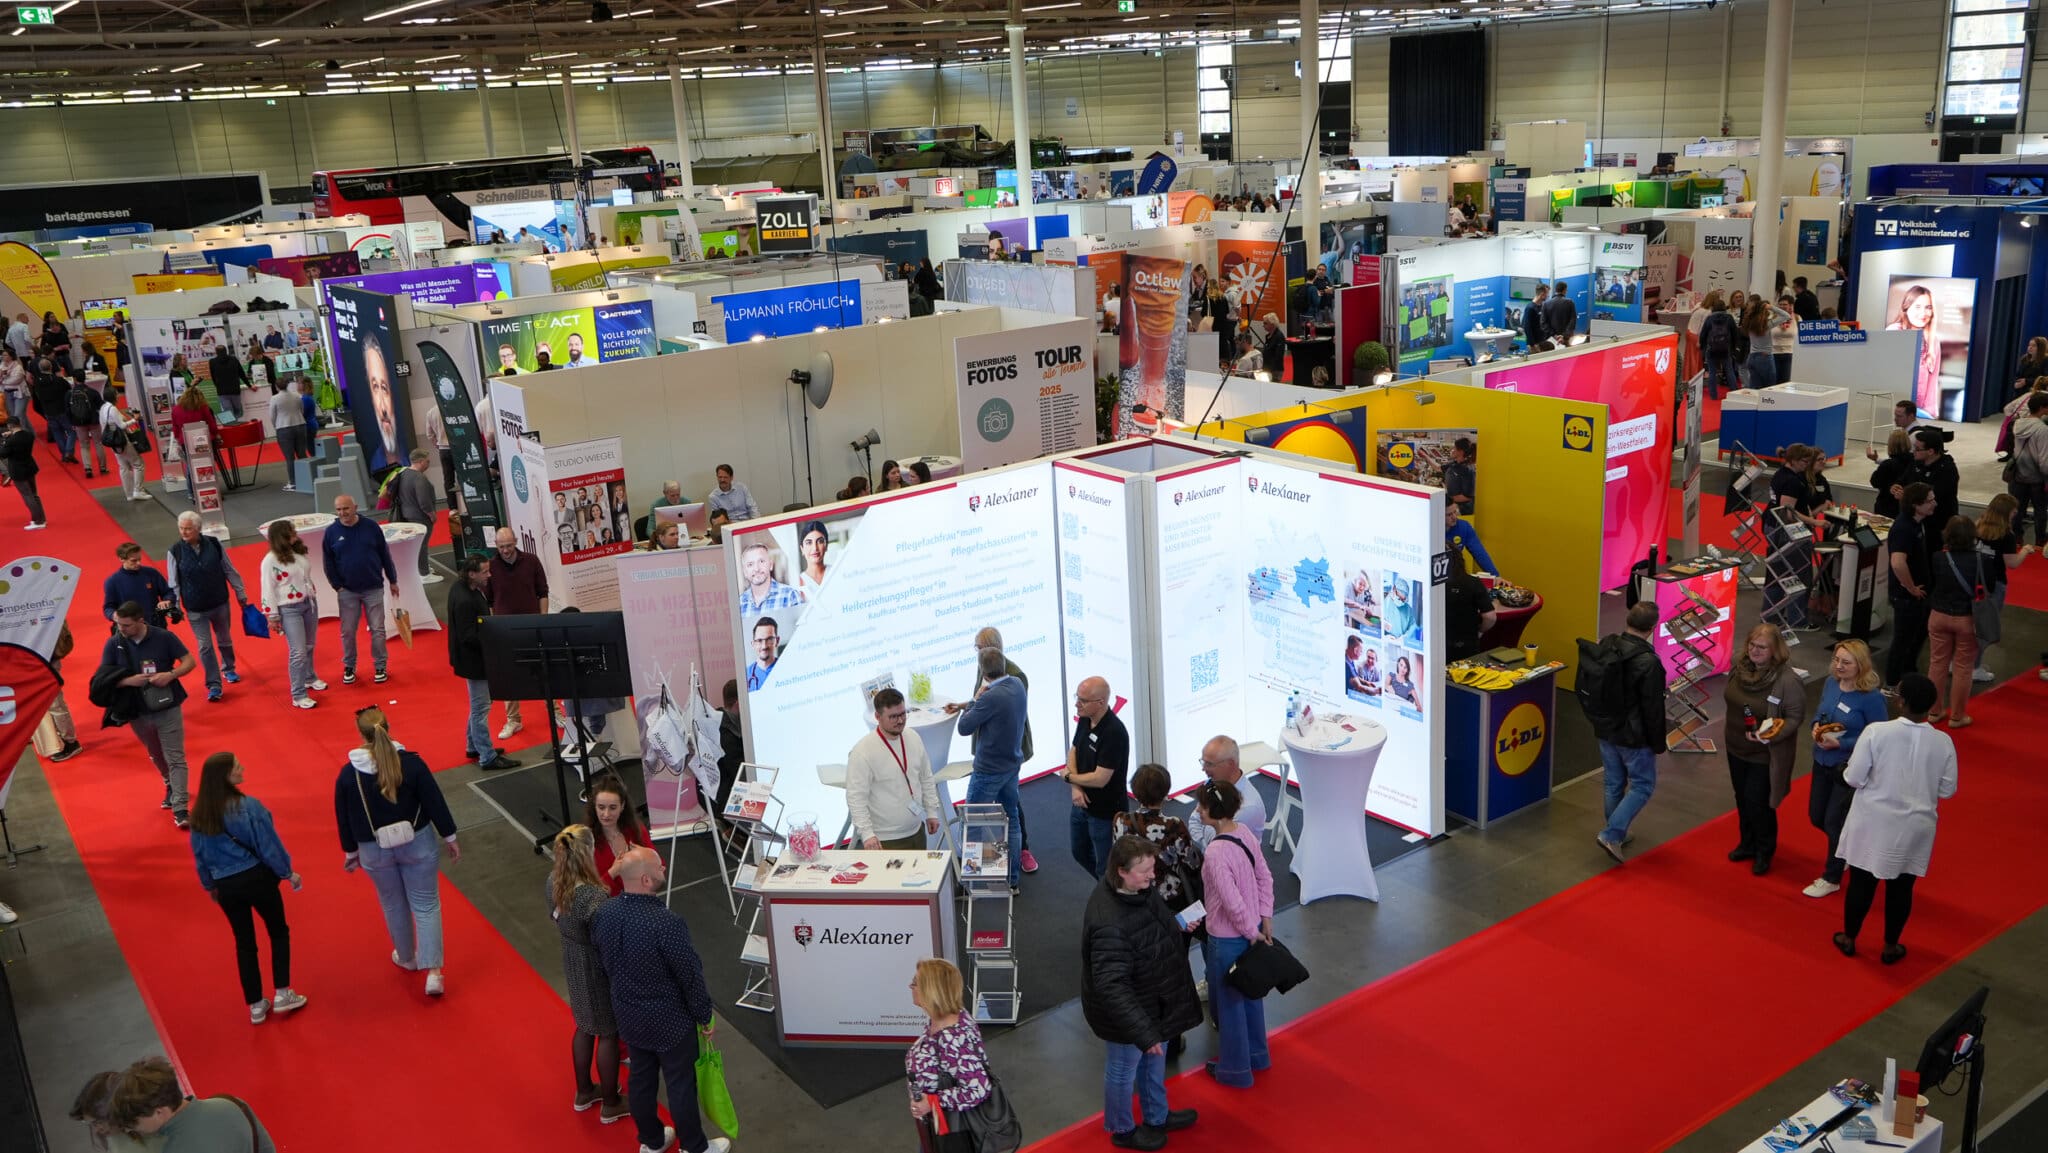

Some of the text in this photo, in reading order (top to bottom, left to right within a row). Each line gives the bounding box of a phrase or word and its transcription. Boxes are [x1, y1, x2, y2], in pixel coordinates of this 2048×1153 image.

[365, 182, 385, 192] WDR
[46, 208, 131, 223] barlagmessen
[761, 212, 807, 229] ZOLL
[1900, 221, 1937, 229] Volksbank
[1704, 235, 1743, 245] BEAUTY
[1910, 229, 1957, 237] Münsterland
[1612, 242, 1634, 250] BSW
[1135, 271, 1182, 289] Outlaw
[608, 309, 642, 319] ACTEMIUM
[724, 303, 784, 323] ALPMANN
[788, 295, 848, 314] FRÖHLICH
[488, 322, 521, 336] TIME
[550, 314, 581, 329] ACT
[1800, 320, 1837, 331] DIE Bank
[602, 328, 652, 340] VOLLE POWER
[1800, 330, 1865, 342] unserer Region.
[603, 337, 641, 349] RICHTUNG
[604, 347, 640, 358] ZUKUNFT
[966, 345, 1082, 369] BEWERBUNGS TOUR
[396, 366, 410, 375] 38
[967, 364, 1018, 386] FOTOS
[1039, 384, 1062, 397] 2025
[1761, 396, 1776, 405] Info
[500, 409, 522, 423] BEWERBUNGS
[501, 418, 524, 439] FOTOS
[1608, 421, 1653, 439] zirksregierung
[1606, 436, 1650, 452] ein-Westfalen.
[554, 451, 616, 469] STUDIO WIEGEL
[560, 473, 616, 489] Nur hier und heute!
[1433, 558, 1449, 578] 07
[0, 599, 54, 614] ompetentia
[935, 605, 961, 618] Duales
[962, 597, 993, 610] Studium
[1021, 582, 1044, 595] Arbeit
[930, 656, 976, 675] ffraumann
[819, 926, 914, 946] Alexianer
